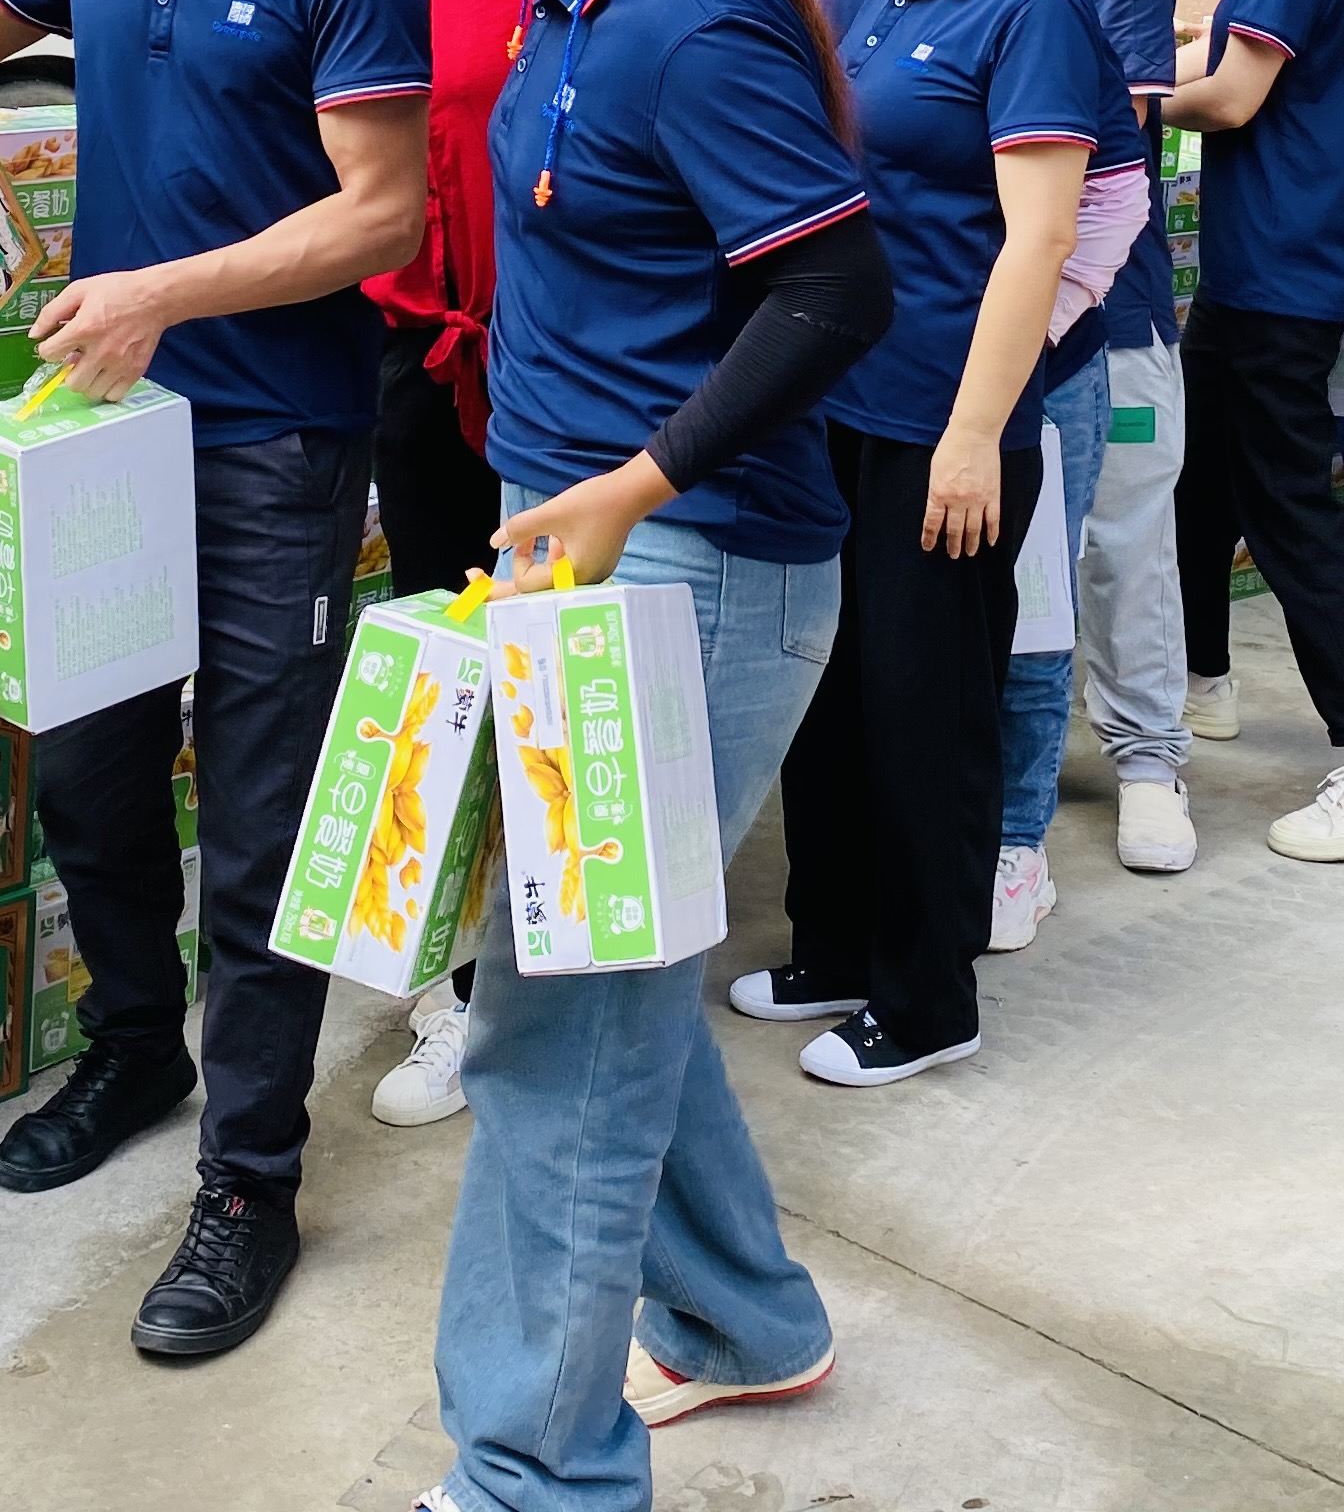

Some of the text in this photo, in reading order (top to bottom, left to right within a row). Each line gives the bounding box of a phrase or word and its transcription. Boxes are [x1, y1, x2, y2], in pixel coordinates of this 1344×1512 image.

[445, 687, 476, 736] 蒙牛
[579, 677, 628, 800] 早餐奶
[305, 774, 368, 890] 早餐奶
[524, 874, 547, 926] 蒙牛
